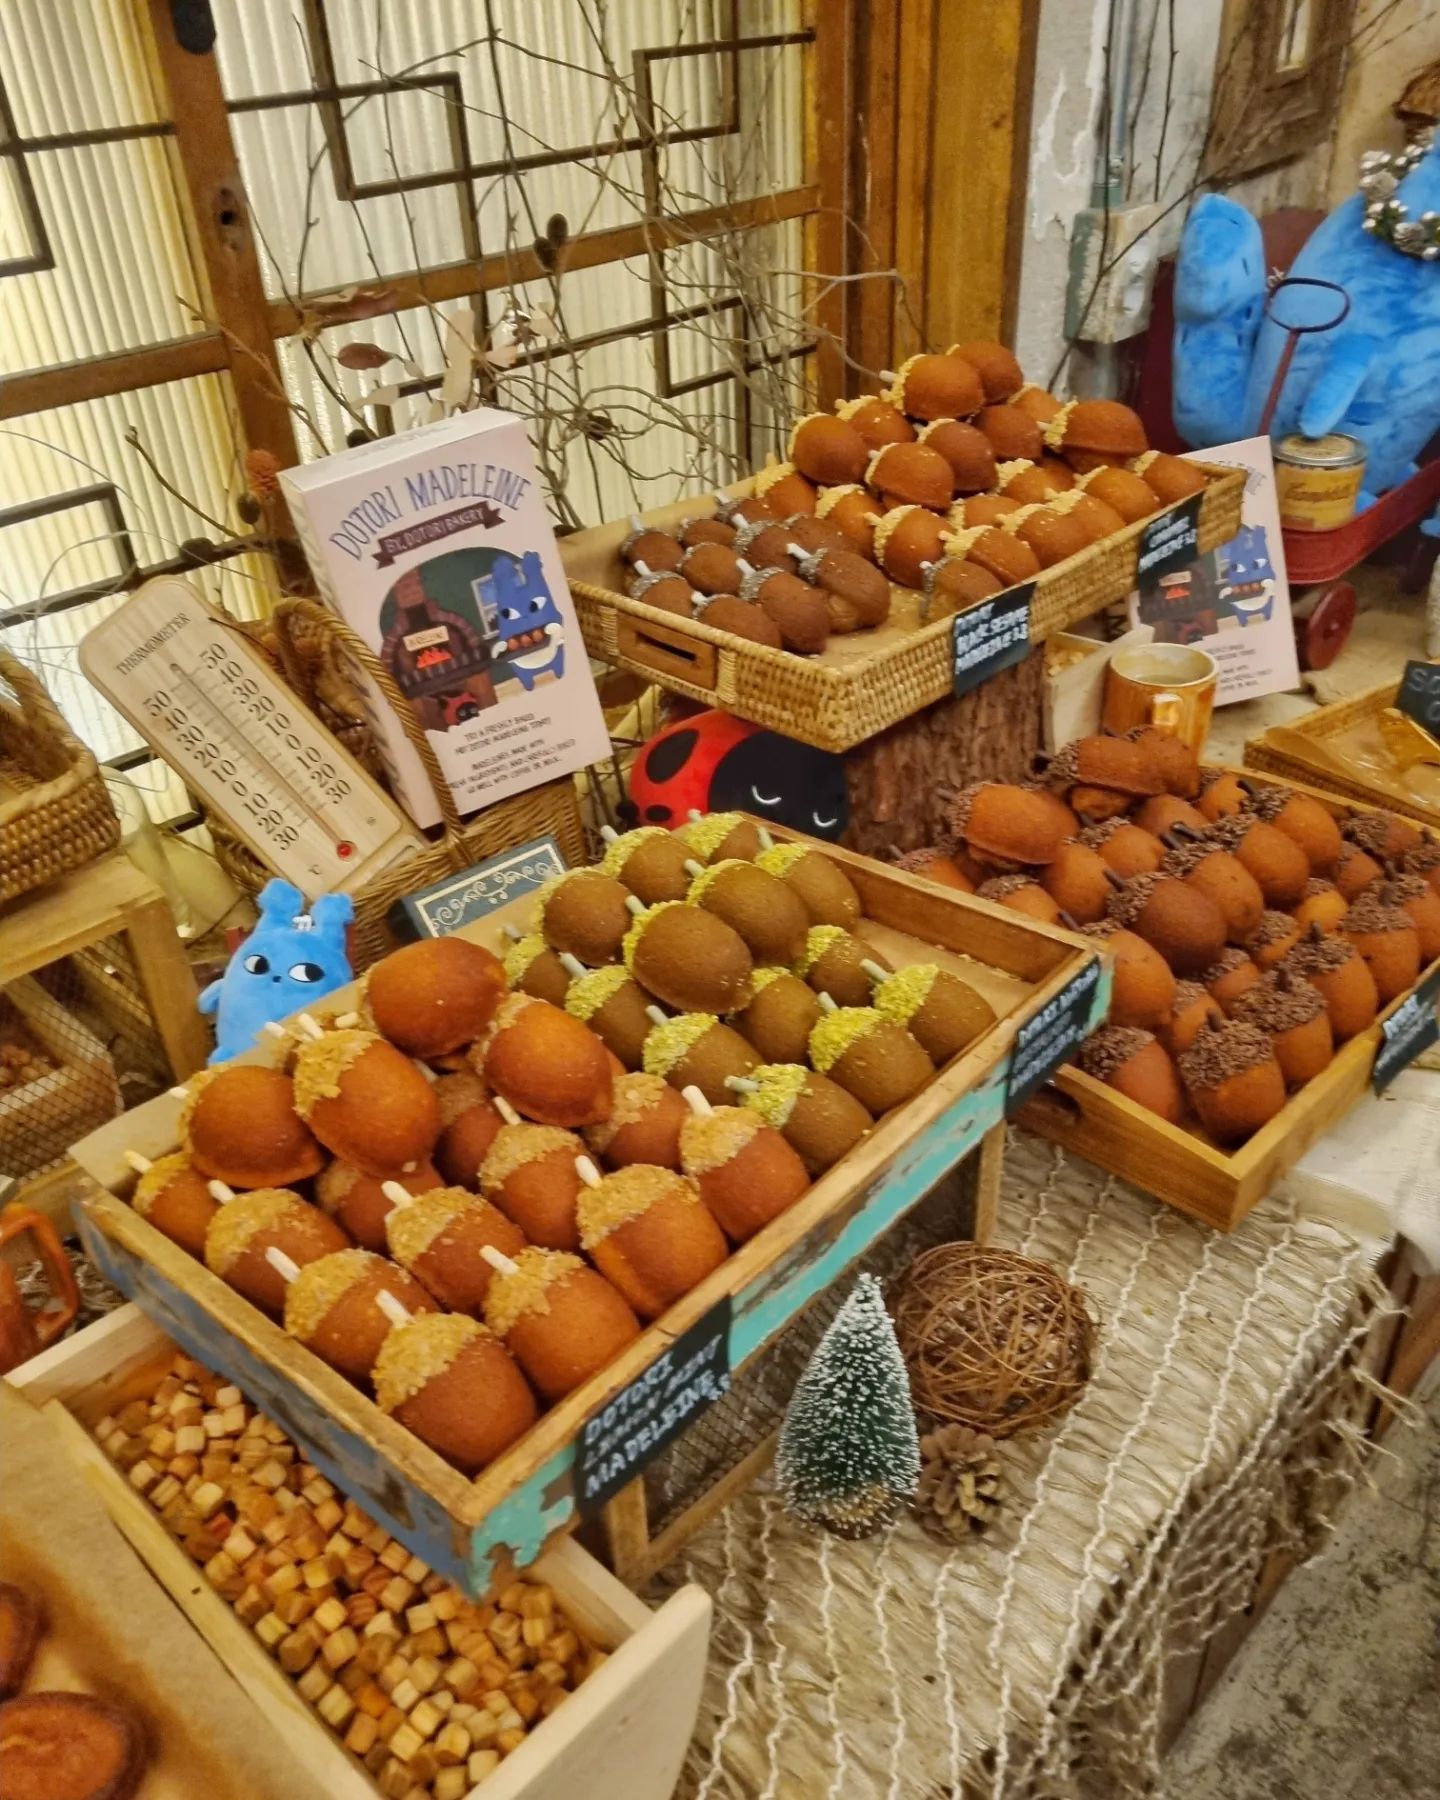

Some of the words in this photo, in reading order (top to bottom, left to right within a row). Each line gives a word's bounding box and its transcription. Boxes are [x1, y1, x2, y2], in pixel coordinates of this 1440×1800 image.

[328, 485, 403, 560] DOTORI
[404, 463, 531, 511] MADELEINE
[115, 612, 191, 675] THERMOMETER
[200, 642, 228, 669] 50
[222, 661, 244, 686] 40
[143, 690, 171, 717] 50
[233, 678, 261, 704] 30
[164, 708, 189, 732] 40
[249, 696, 276, 721] 20
[265, 713, 291, 737] 10
[177, 725, 205, 752] 30
[286, 734, 301, 751] 0
[193, 743, 220, 769] 20
[296, 746, 323, 771] 10
[211, 760, 238, 784] 10
[311, 763, 336, 788] 20
[232, 780, 248, 797] 0
[326, 779, 352, 805] 30
[241, 793, 269, 818] 10
[258, 810, 284, 835] 20
[272, 825, 300, 851] 30
[585, 1370, 715, 1498] MADELEINE
